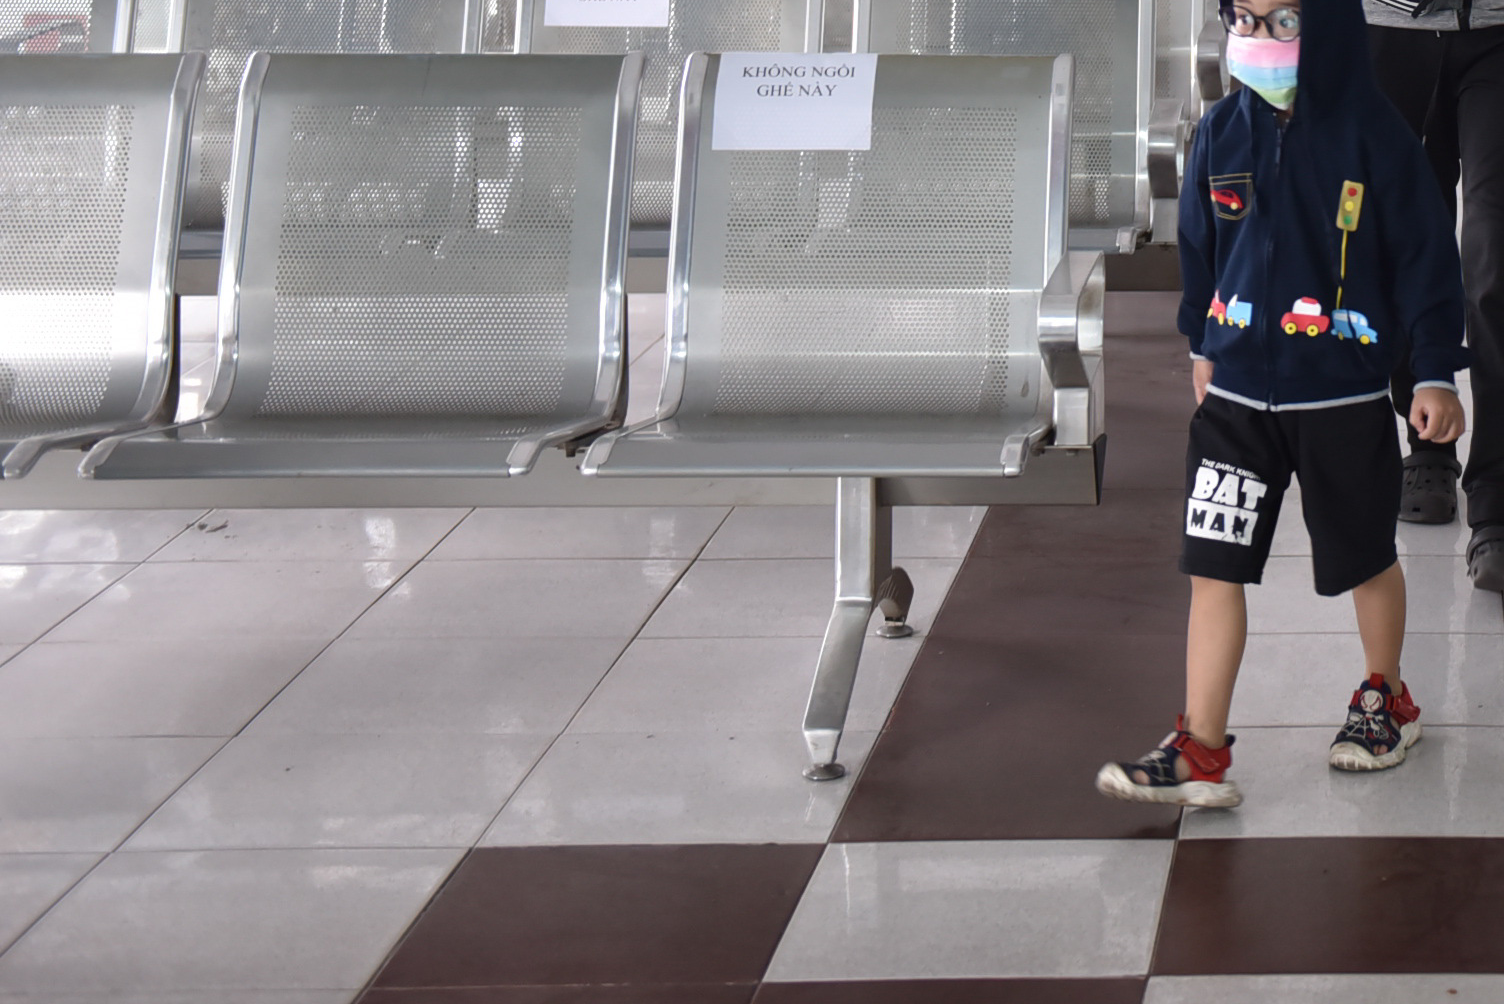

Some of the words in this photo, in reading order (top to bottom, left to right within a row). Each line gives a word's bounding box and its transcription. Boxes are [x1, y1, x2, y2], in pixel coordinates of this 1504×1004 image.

[742, 63, 806, 78] KHÔNG
[798, 81, 837, 97] NÀY
[1201, 457, 1215, 469] THE
[1215, 462, 1236, 474] DARK
[1191, 466, 1268, 511] BAT
[1190, 507, 1249, 538] MAN
